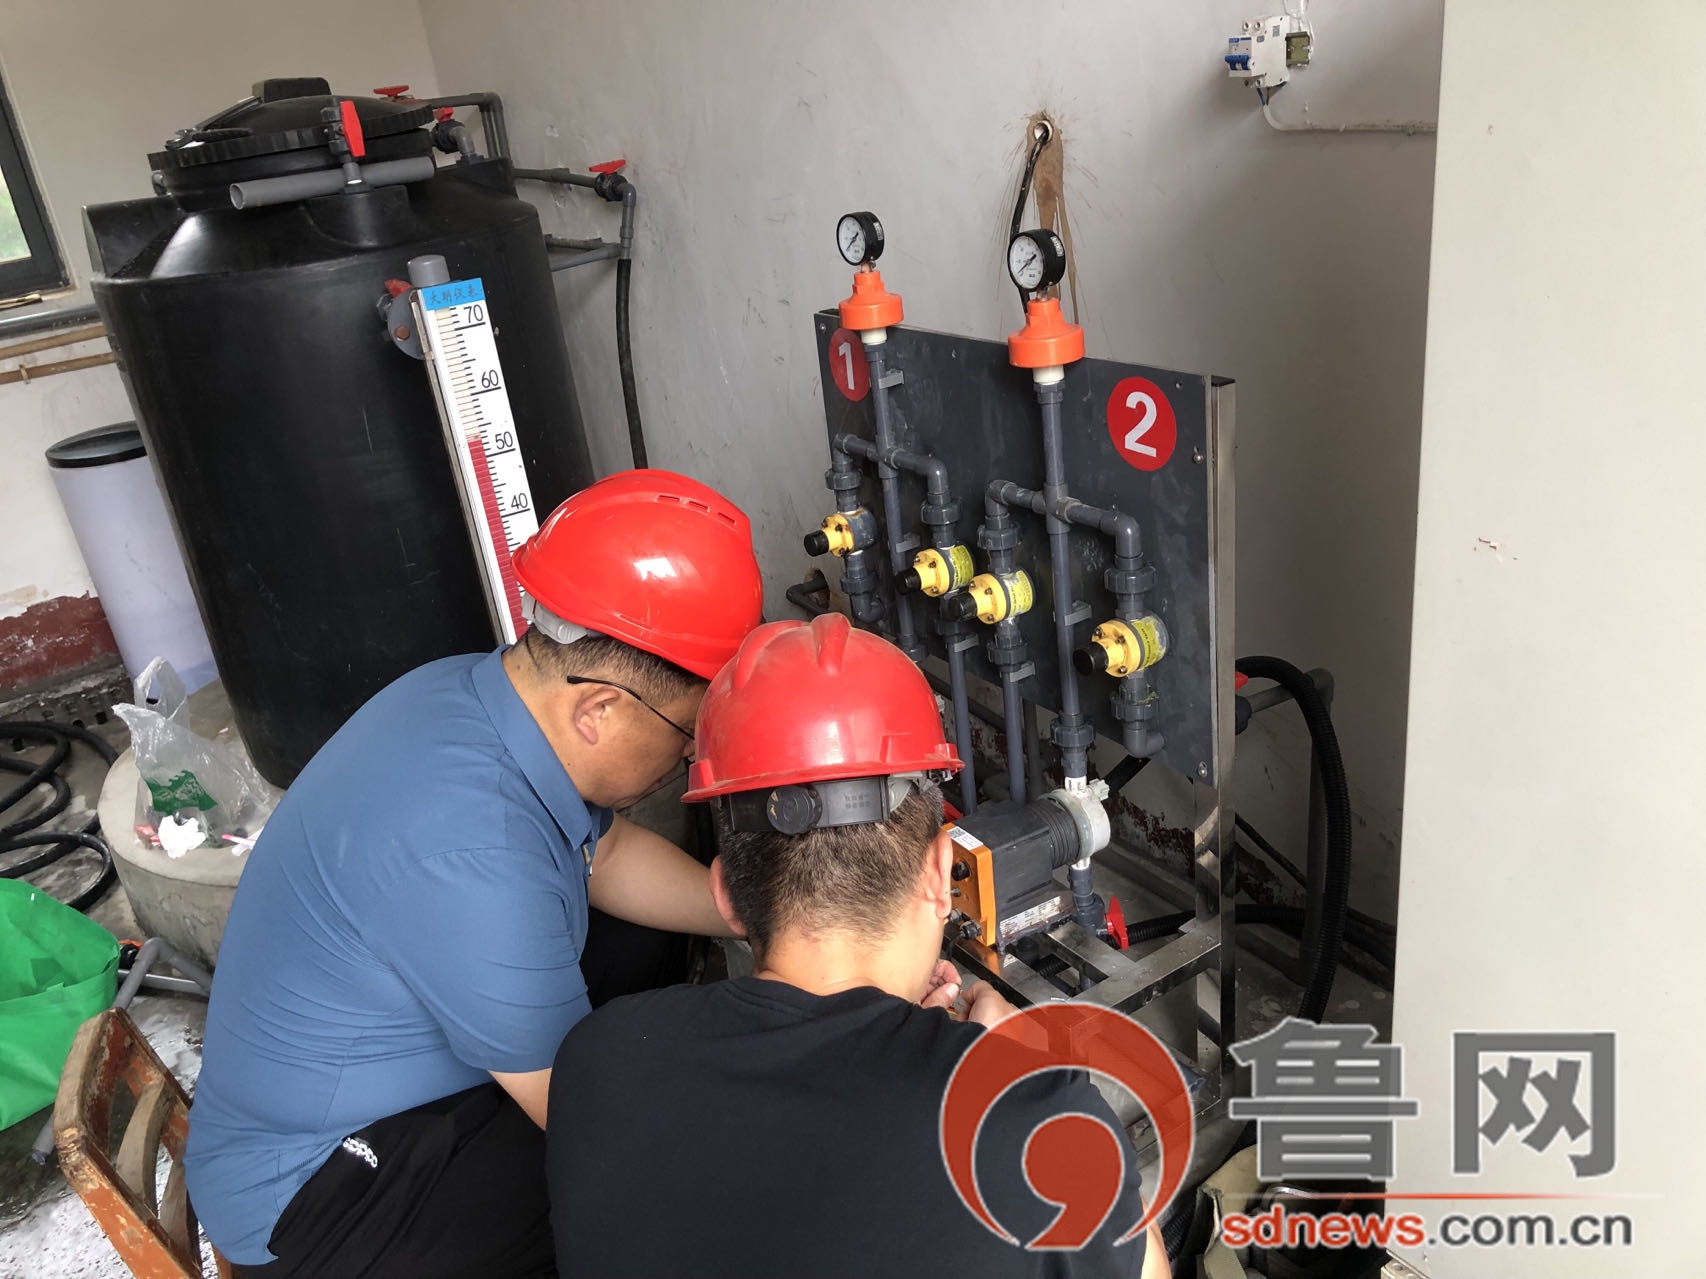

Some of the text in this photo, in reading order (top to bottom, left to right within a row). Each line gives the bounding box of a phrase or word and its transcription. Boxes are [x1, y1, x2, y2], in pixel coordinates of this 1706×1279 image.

[465, 304, 484, 323] 70
[839, 342, 855, 390] 1
[481, 369, 499, 388] 60
[1124, 391, 1157, 458] 2
[495, 431, 513, 449] 50
[510, 492, 528, 510] 40
